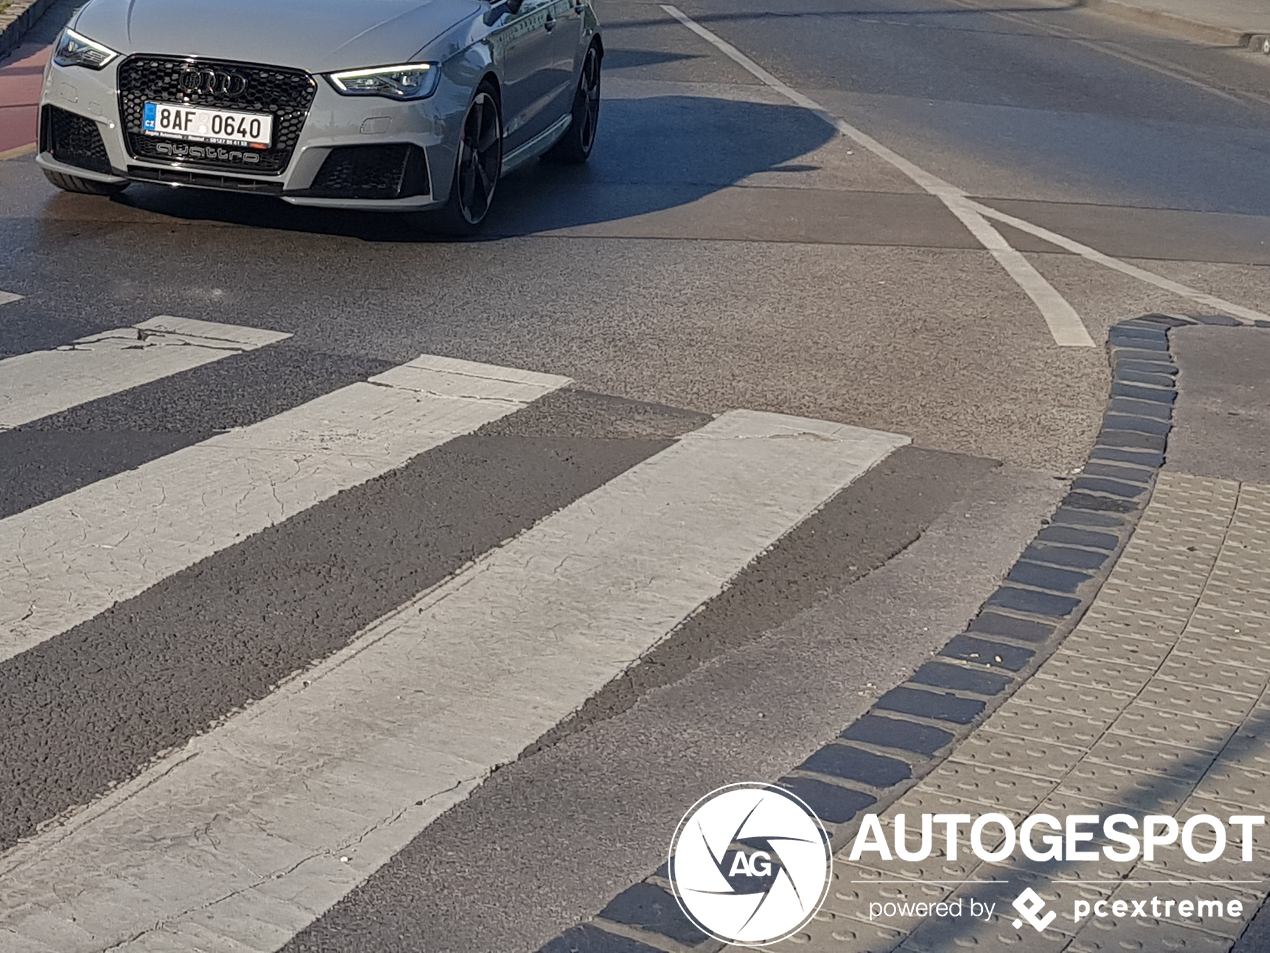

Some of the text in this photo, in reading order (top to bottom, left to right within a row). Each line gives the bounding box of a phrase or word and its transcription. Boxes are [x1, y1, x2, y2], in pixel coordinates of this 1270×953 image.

[145, 119, 155, 127] CZ
[160, 108, 196, 131] 8AF
[211, 114, 261, 139] 0640
[156, 142, 260, 163] quattro
